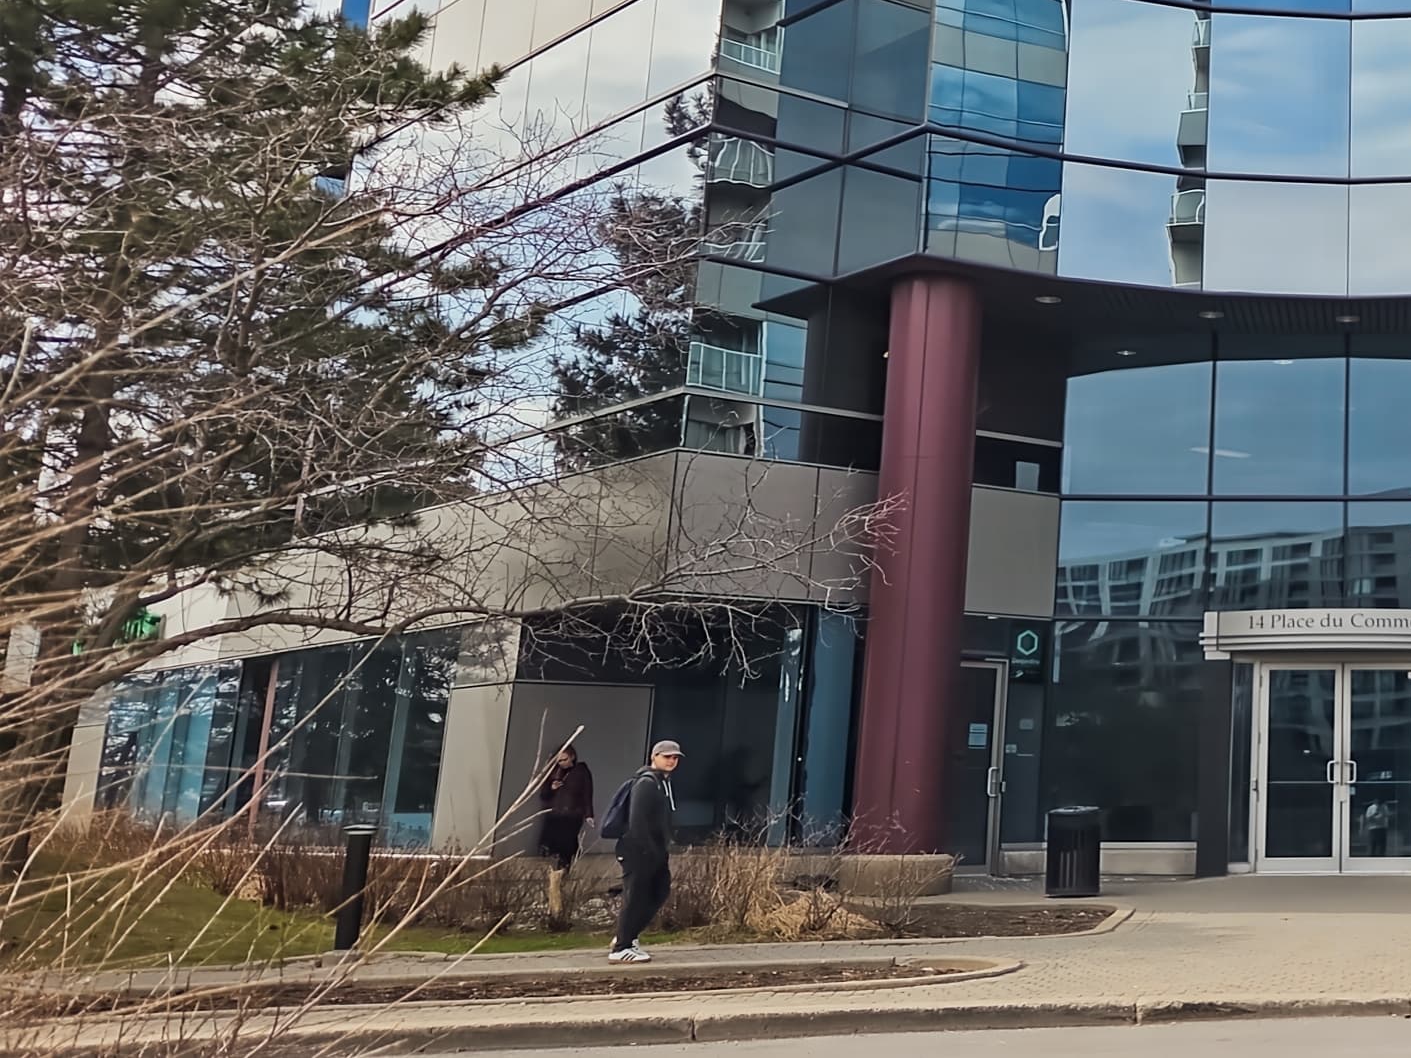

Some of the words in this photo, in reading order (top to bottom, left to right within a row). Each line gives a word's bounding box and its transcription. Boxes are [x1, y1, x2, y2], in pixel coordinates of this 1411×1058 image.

[1248, 614, 1264, 629] 14
[1271, 613, 1314, 629] Place
[1320, 613, 1343, 628] du
